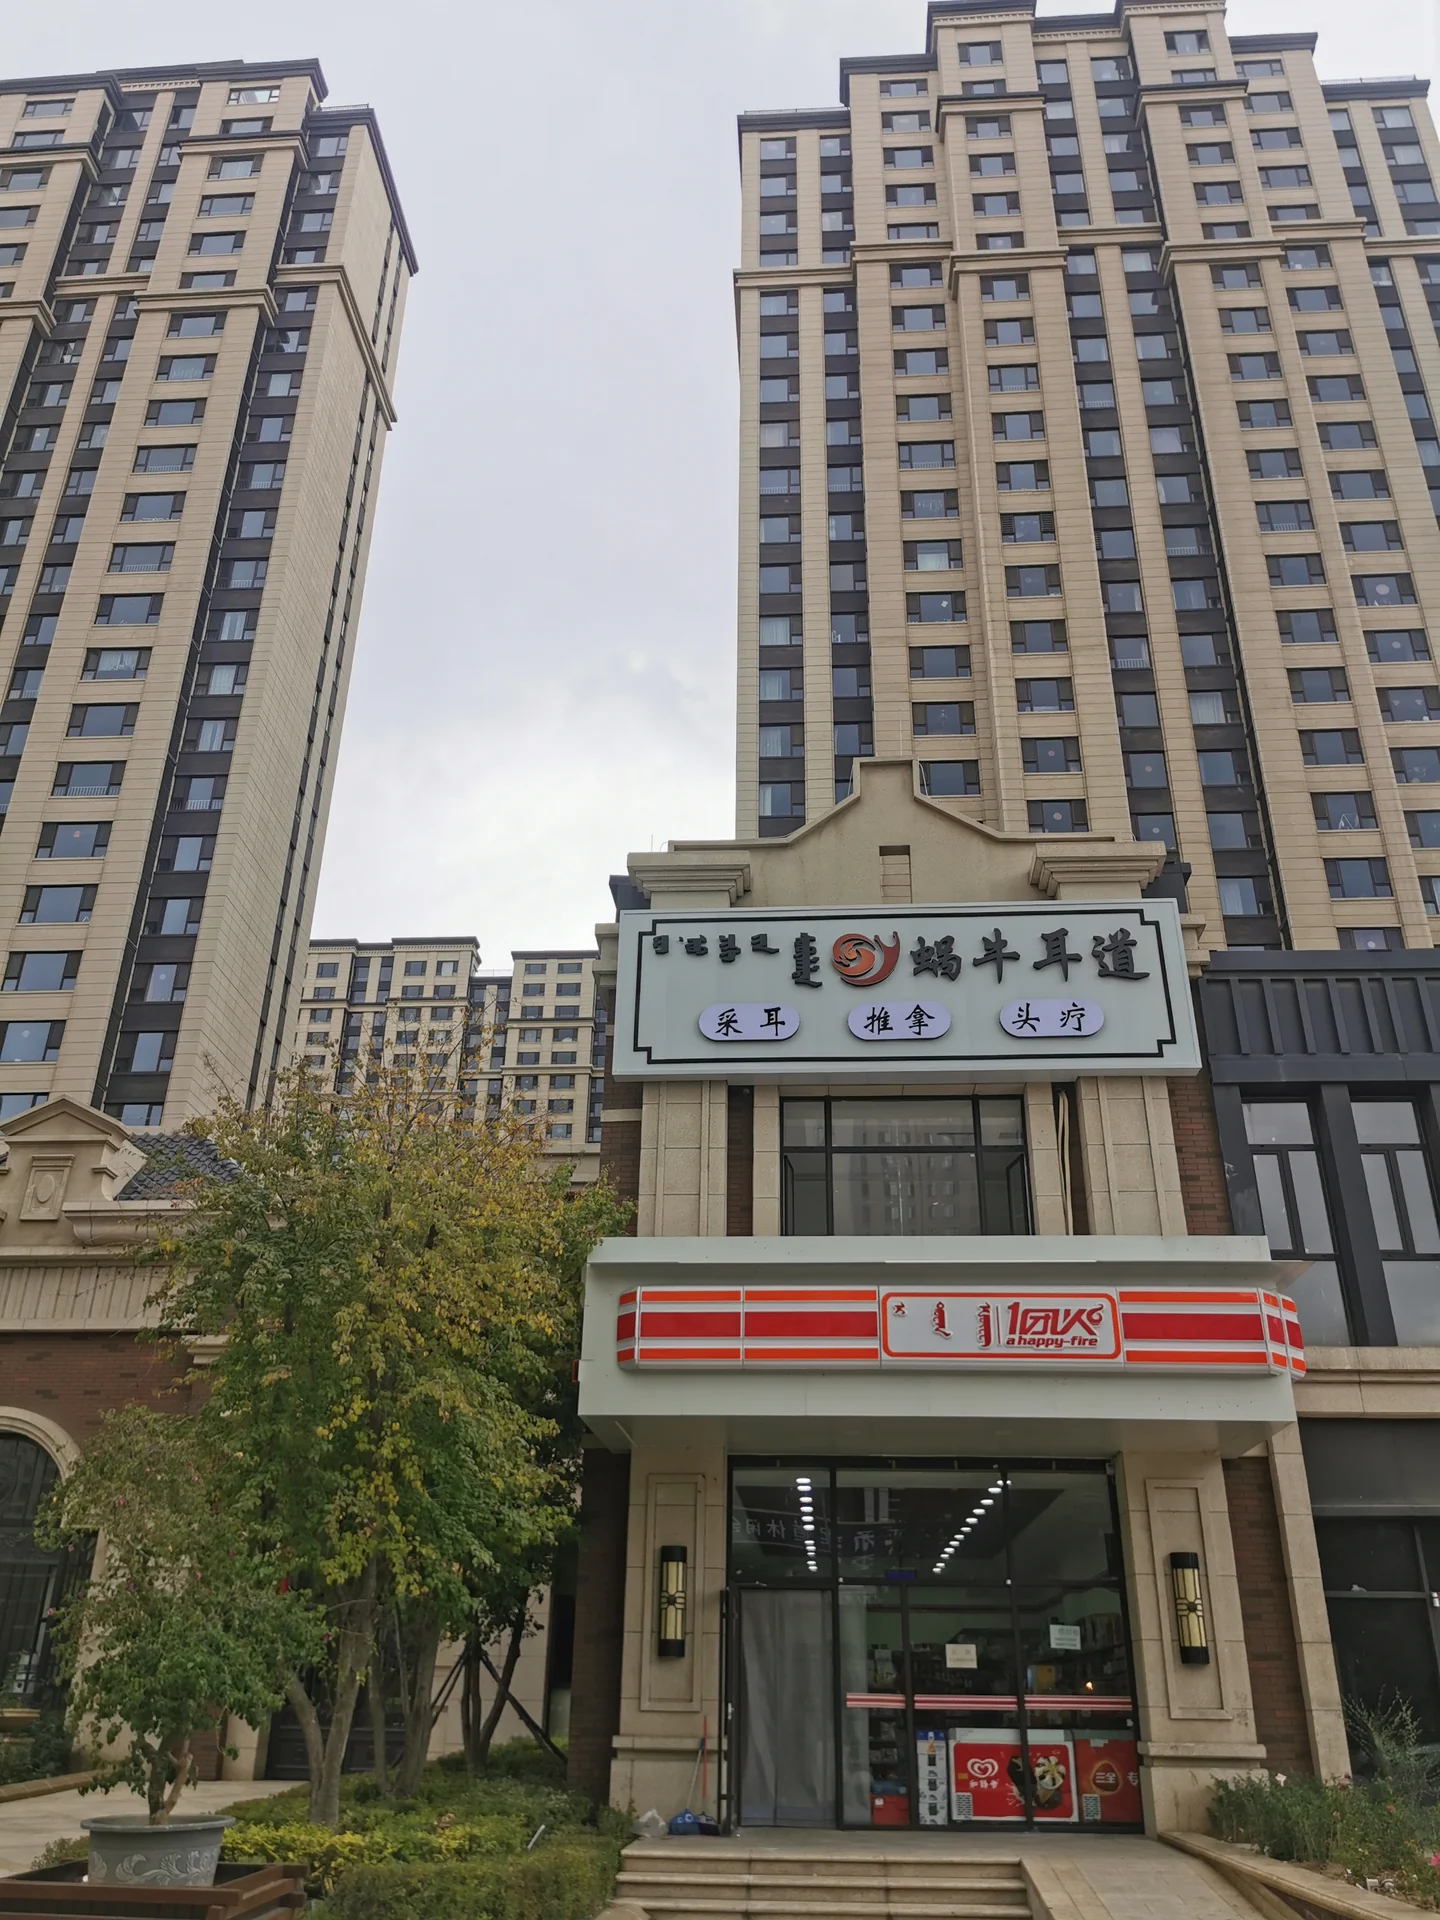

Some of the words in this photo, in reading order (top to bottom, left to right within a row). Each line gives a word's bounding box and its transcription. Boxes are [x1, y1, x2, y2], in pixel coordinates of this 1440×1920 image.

[909, 927, 1150, 983] 蜗牛耳道
[714, 1006, 787, 1037] 采耳
[863, 1005, 936, 1036] 推拿
[1010, 1001, 1090, 1033] 头疗
[1005, 1337, 1015, 1345] a
[1017, 1335, 1099, 1348] happy-fire
[1095, 1771, 1117, 1784] 三全
